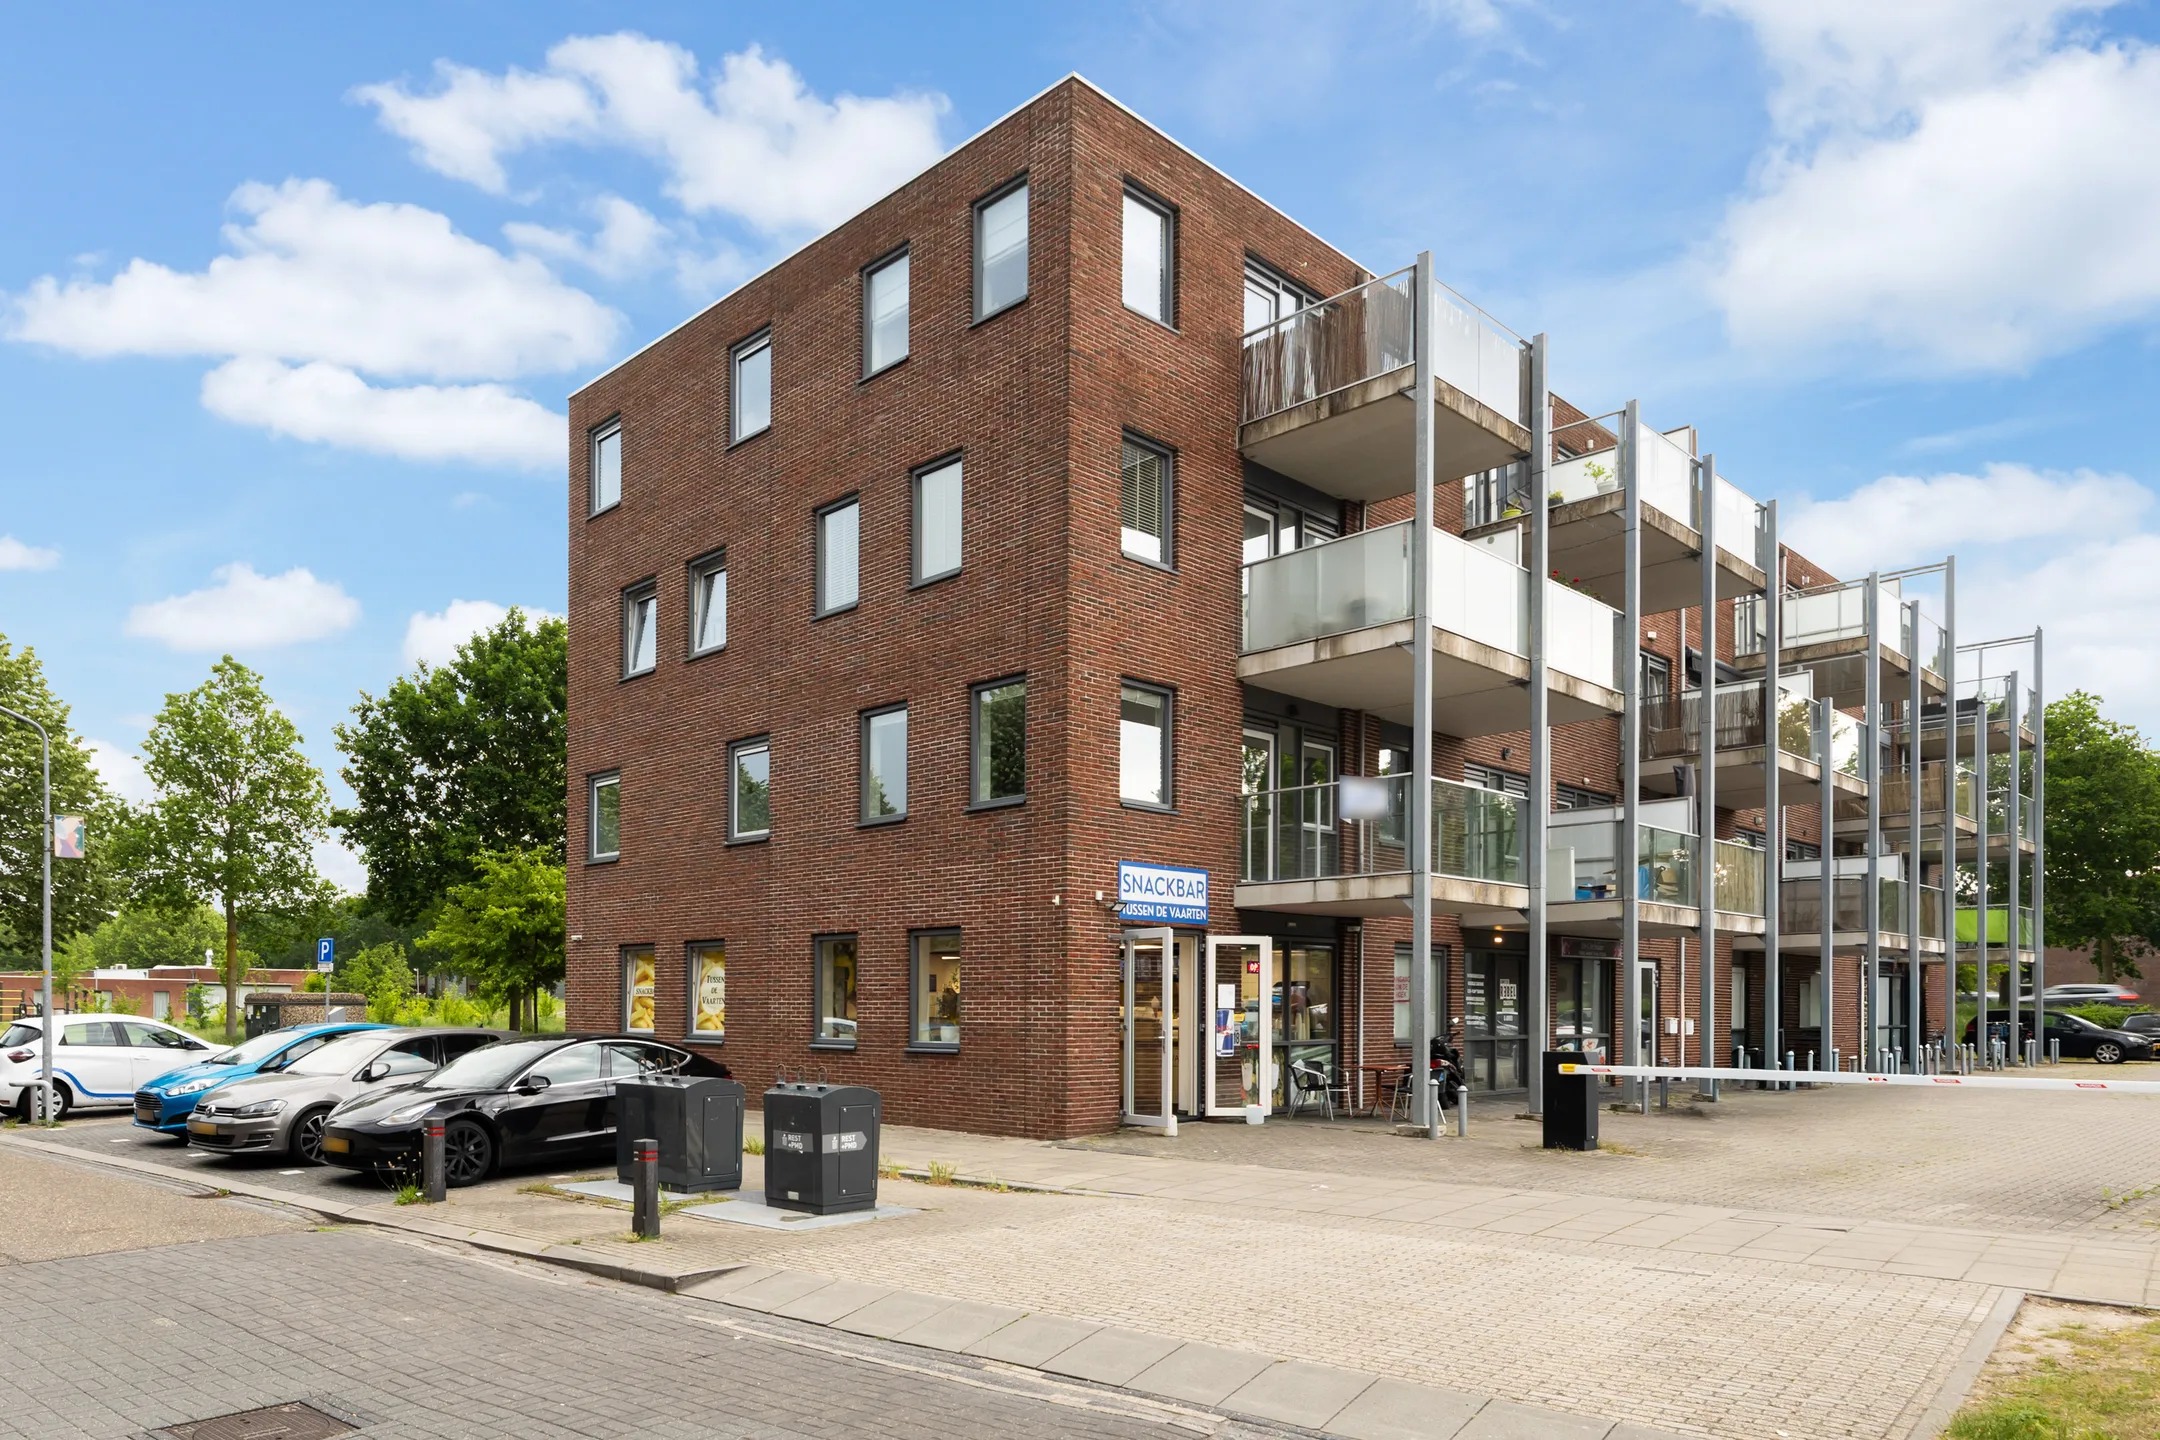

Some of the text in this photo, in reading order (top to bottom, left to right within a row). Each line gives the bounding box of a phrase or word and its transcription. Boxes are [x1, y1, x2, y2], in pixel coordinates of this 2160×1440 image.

[1122, 873, 1205, 900] SNACKBAR
[1156, 906, 1168, 917] DE
[1169, 906, 1207, 920] VAARTEN
[321, 941, 330, 960] P
[706, 975, 725, 984] TUSSEN
[636, 987, 655, 995] SNACKB
[702, 996, 726, 1005] VAARTEN
[841, 1134, 856, 1142] REST
